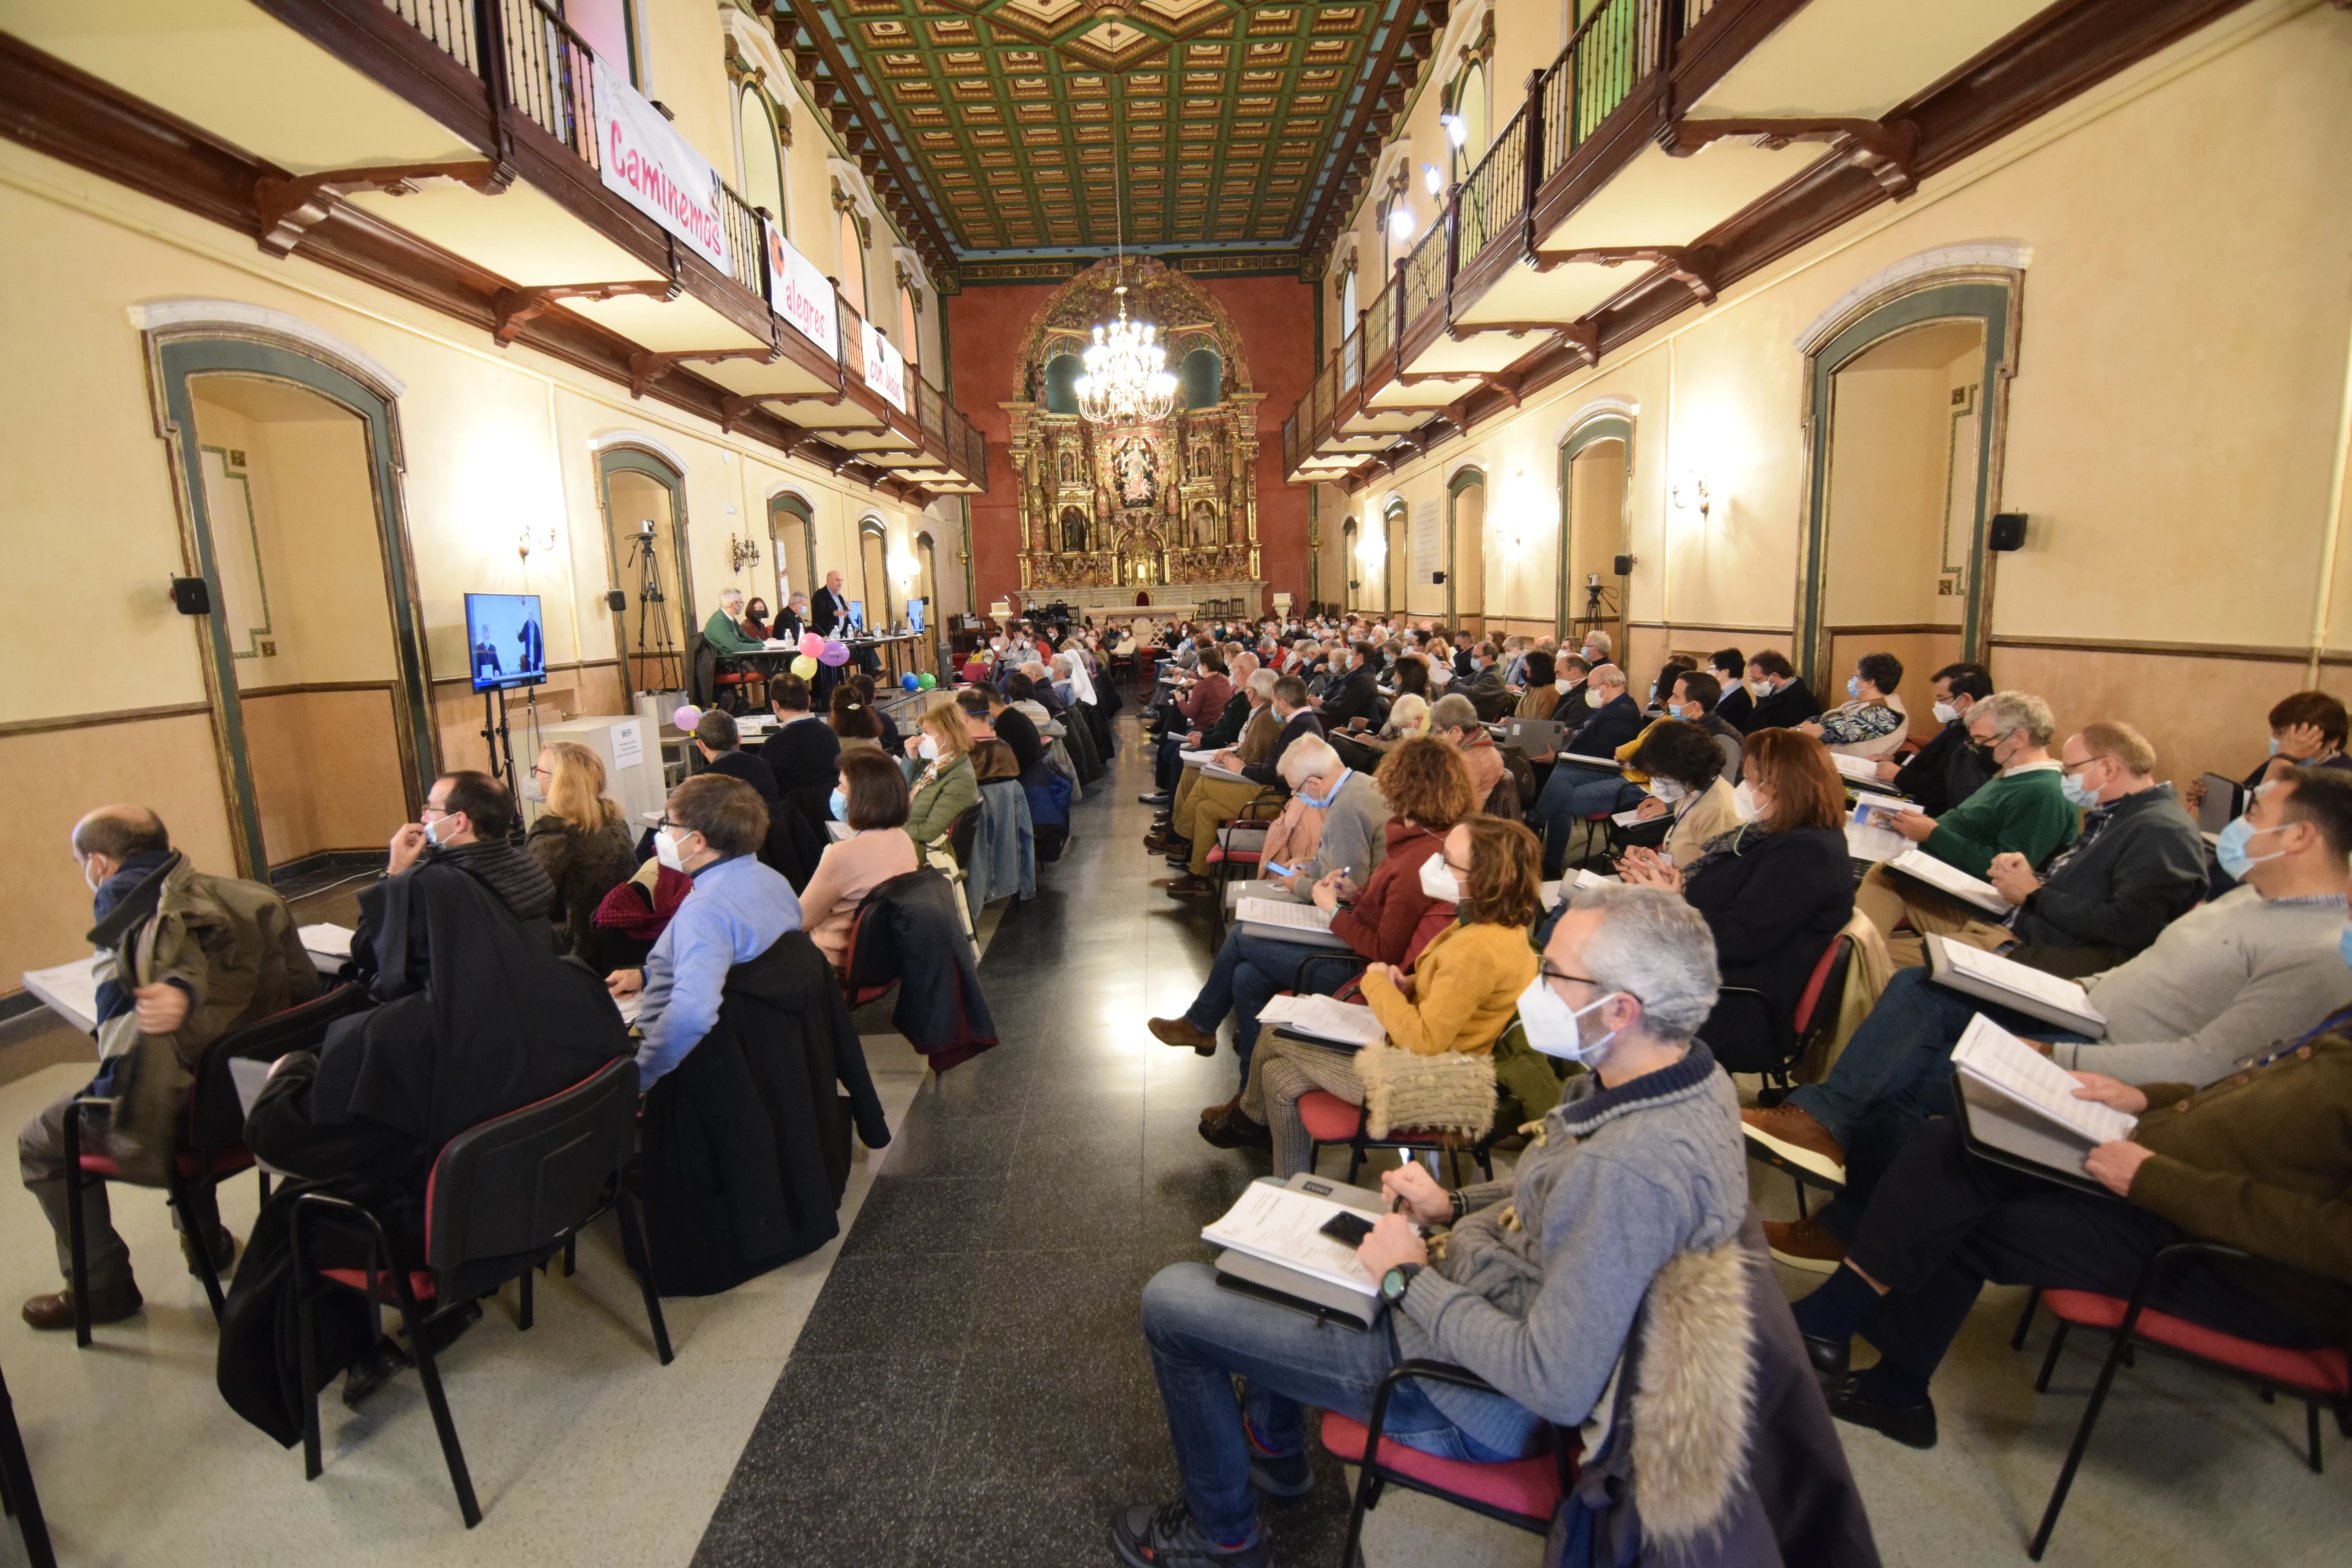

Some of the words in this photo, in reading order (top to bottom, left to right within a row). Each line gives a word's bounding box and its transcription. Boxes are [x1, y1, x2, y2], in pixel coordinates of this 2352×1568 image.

[610, 119, 722, 256] Caminemos
[786, 279, 824, 338] alegres
[870, 359, 883, 387] con
[621, 728, 633, 738] WIFI
